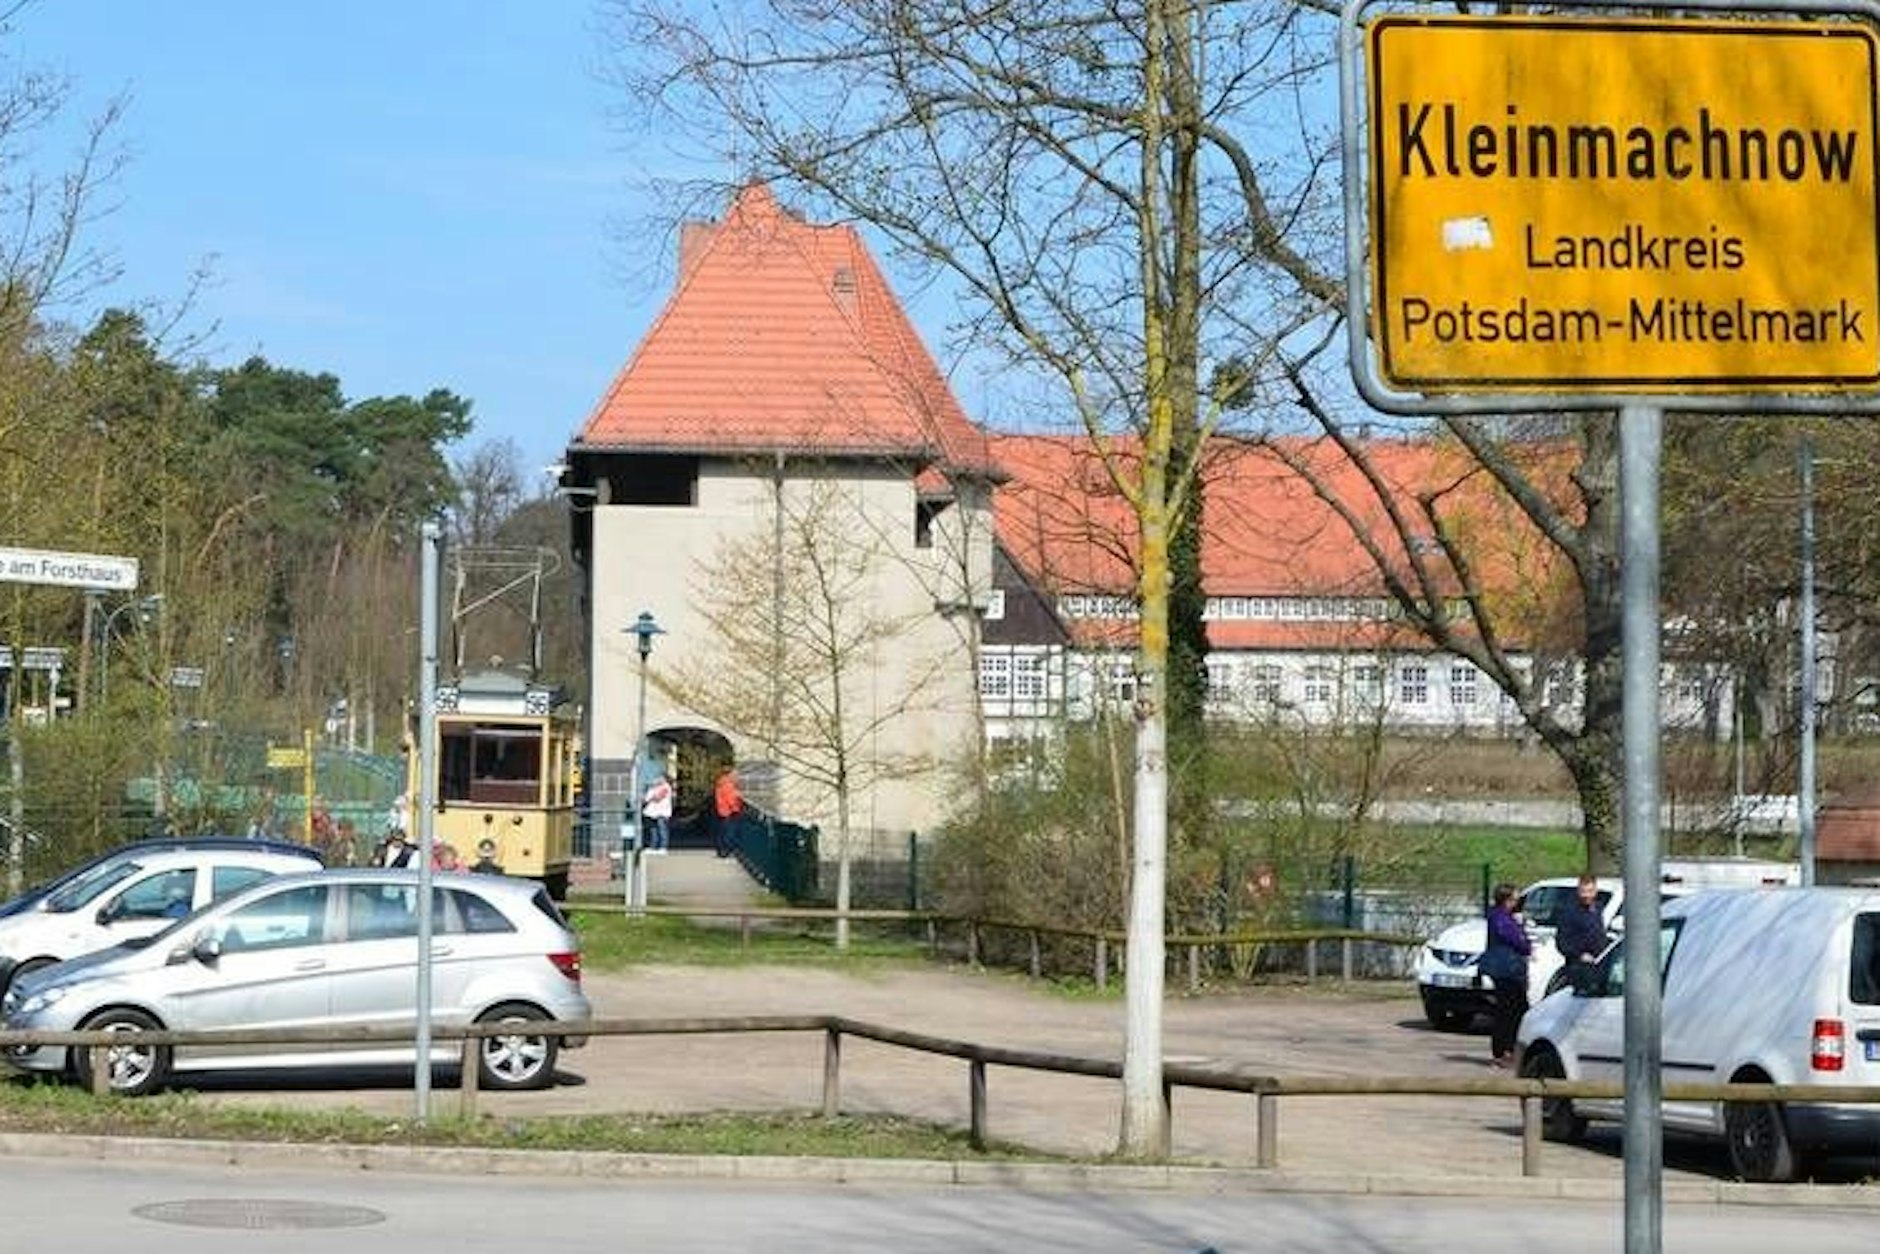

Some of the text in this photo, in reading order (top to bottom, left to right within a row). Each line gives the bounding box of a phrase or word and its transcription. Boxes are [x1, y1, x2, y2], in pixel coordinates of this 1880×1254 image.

[1400, 103, 1857, 182] Kleinmachnow
[1526, 225, 1745, 269] Landkreis
[1402, 298, 1864, 343] Potsdam-Mittelmark
